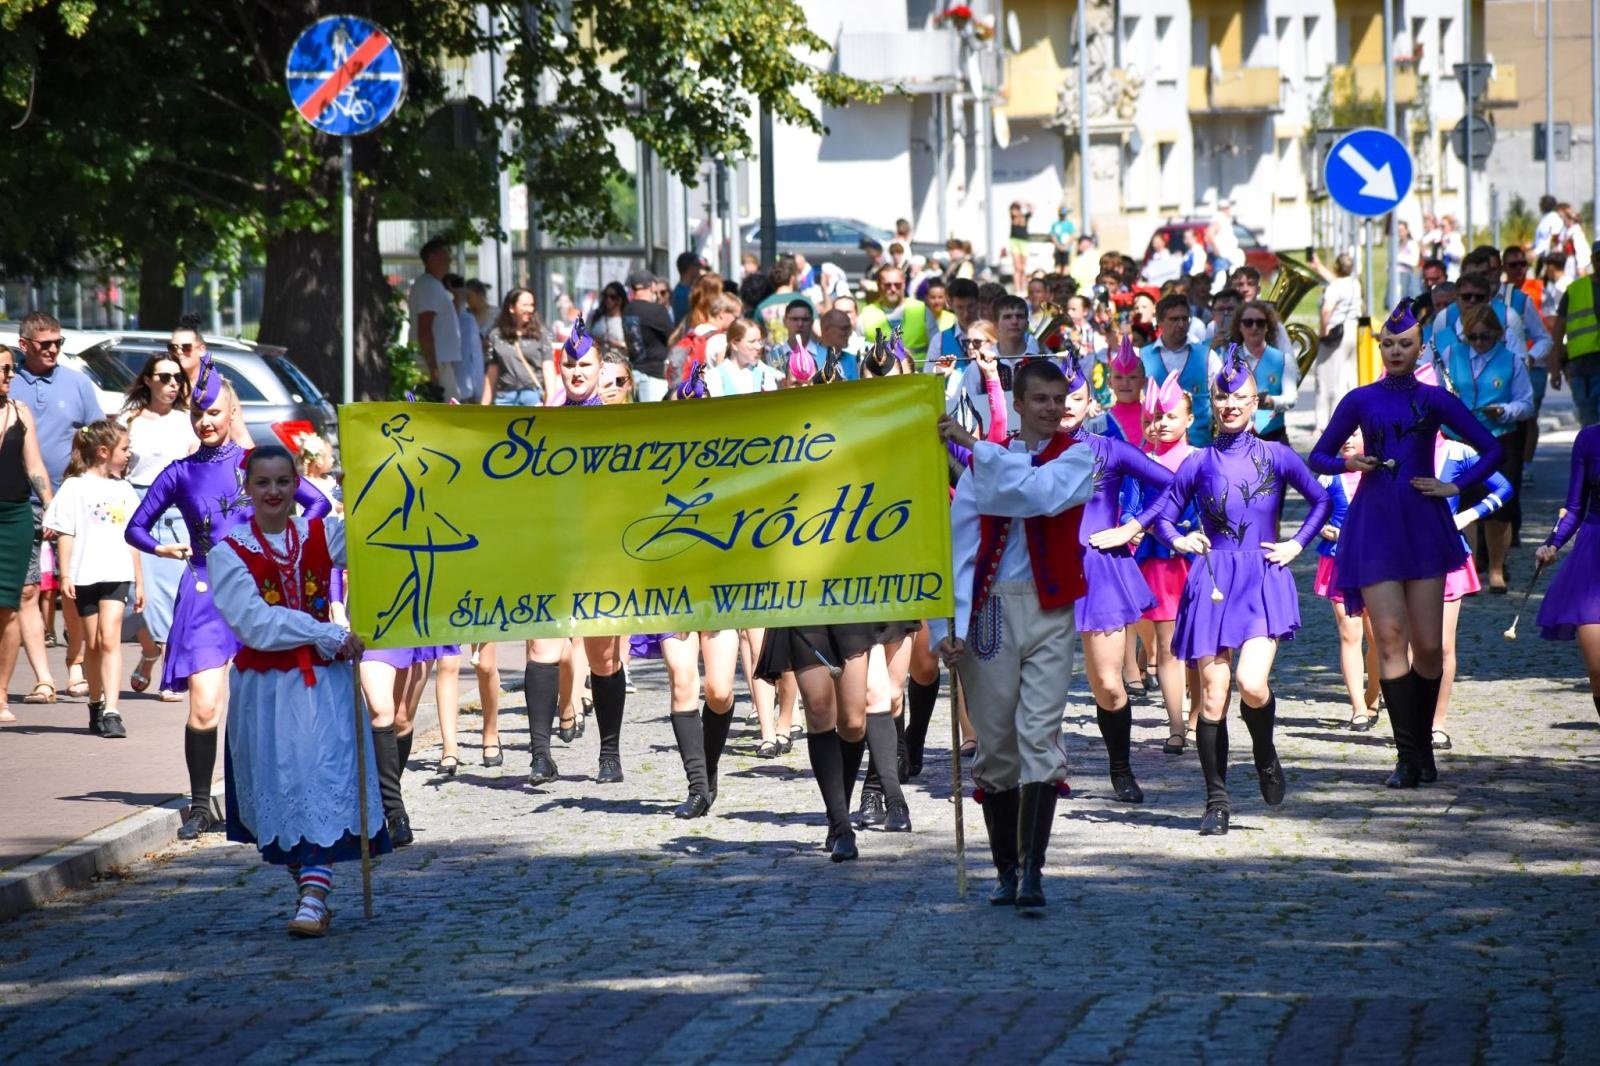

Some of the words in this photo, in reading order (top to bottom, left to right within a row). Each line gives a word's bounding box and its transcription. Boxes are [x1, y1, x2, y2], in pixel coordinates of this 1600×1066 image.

[482, 416, 836, 485] Stowarzyszenie
[622, 477, 913, 562] Źródło
[449, 590, 558, 632] ŚLĄSK
[571, 585, 694, 621] KRAINA
[710, 579, 808, 614] WIELU
[818, 571, 944, 608] KULTUR
